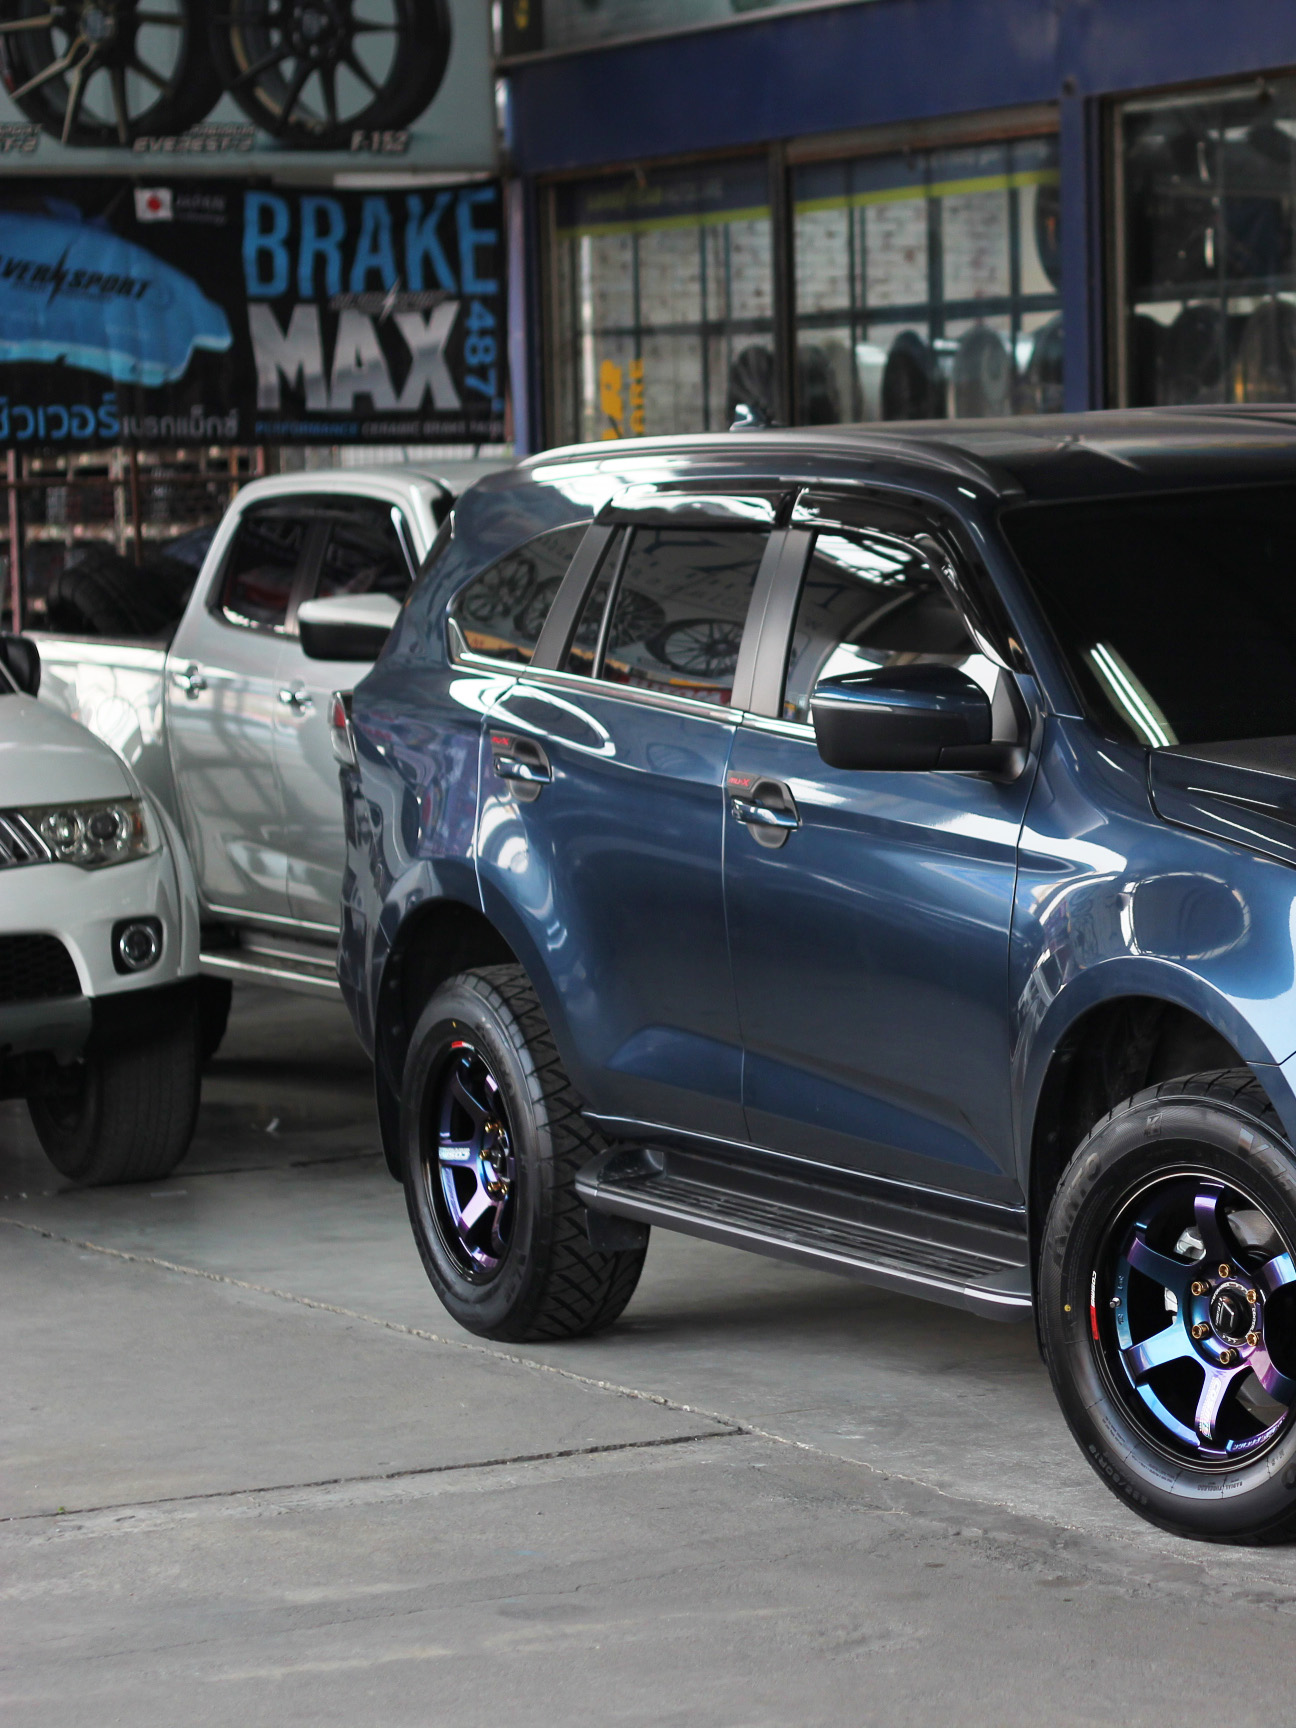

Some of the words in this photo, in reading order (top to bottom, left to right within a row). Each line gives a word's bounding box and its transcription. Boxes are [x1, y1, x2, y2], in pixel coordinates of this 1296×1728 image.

[67, 267, 153, 301] SPORT
[242, 187, 498, 298] BRAKE
[246, 301, 461, 412] MAX
